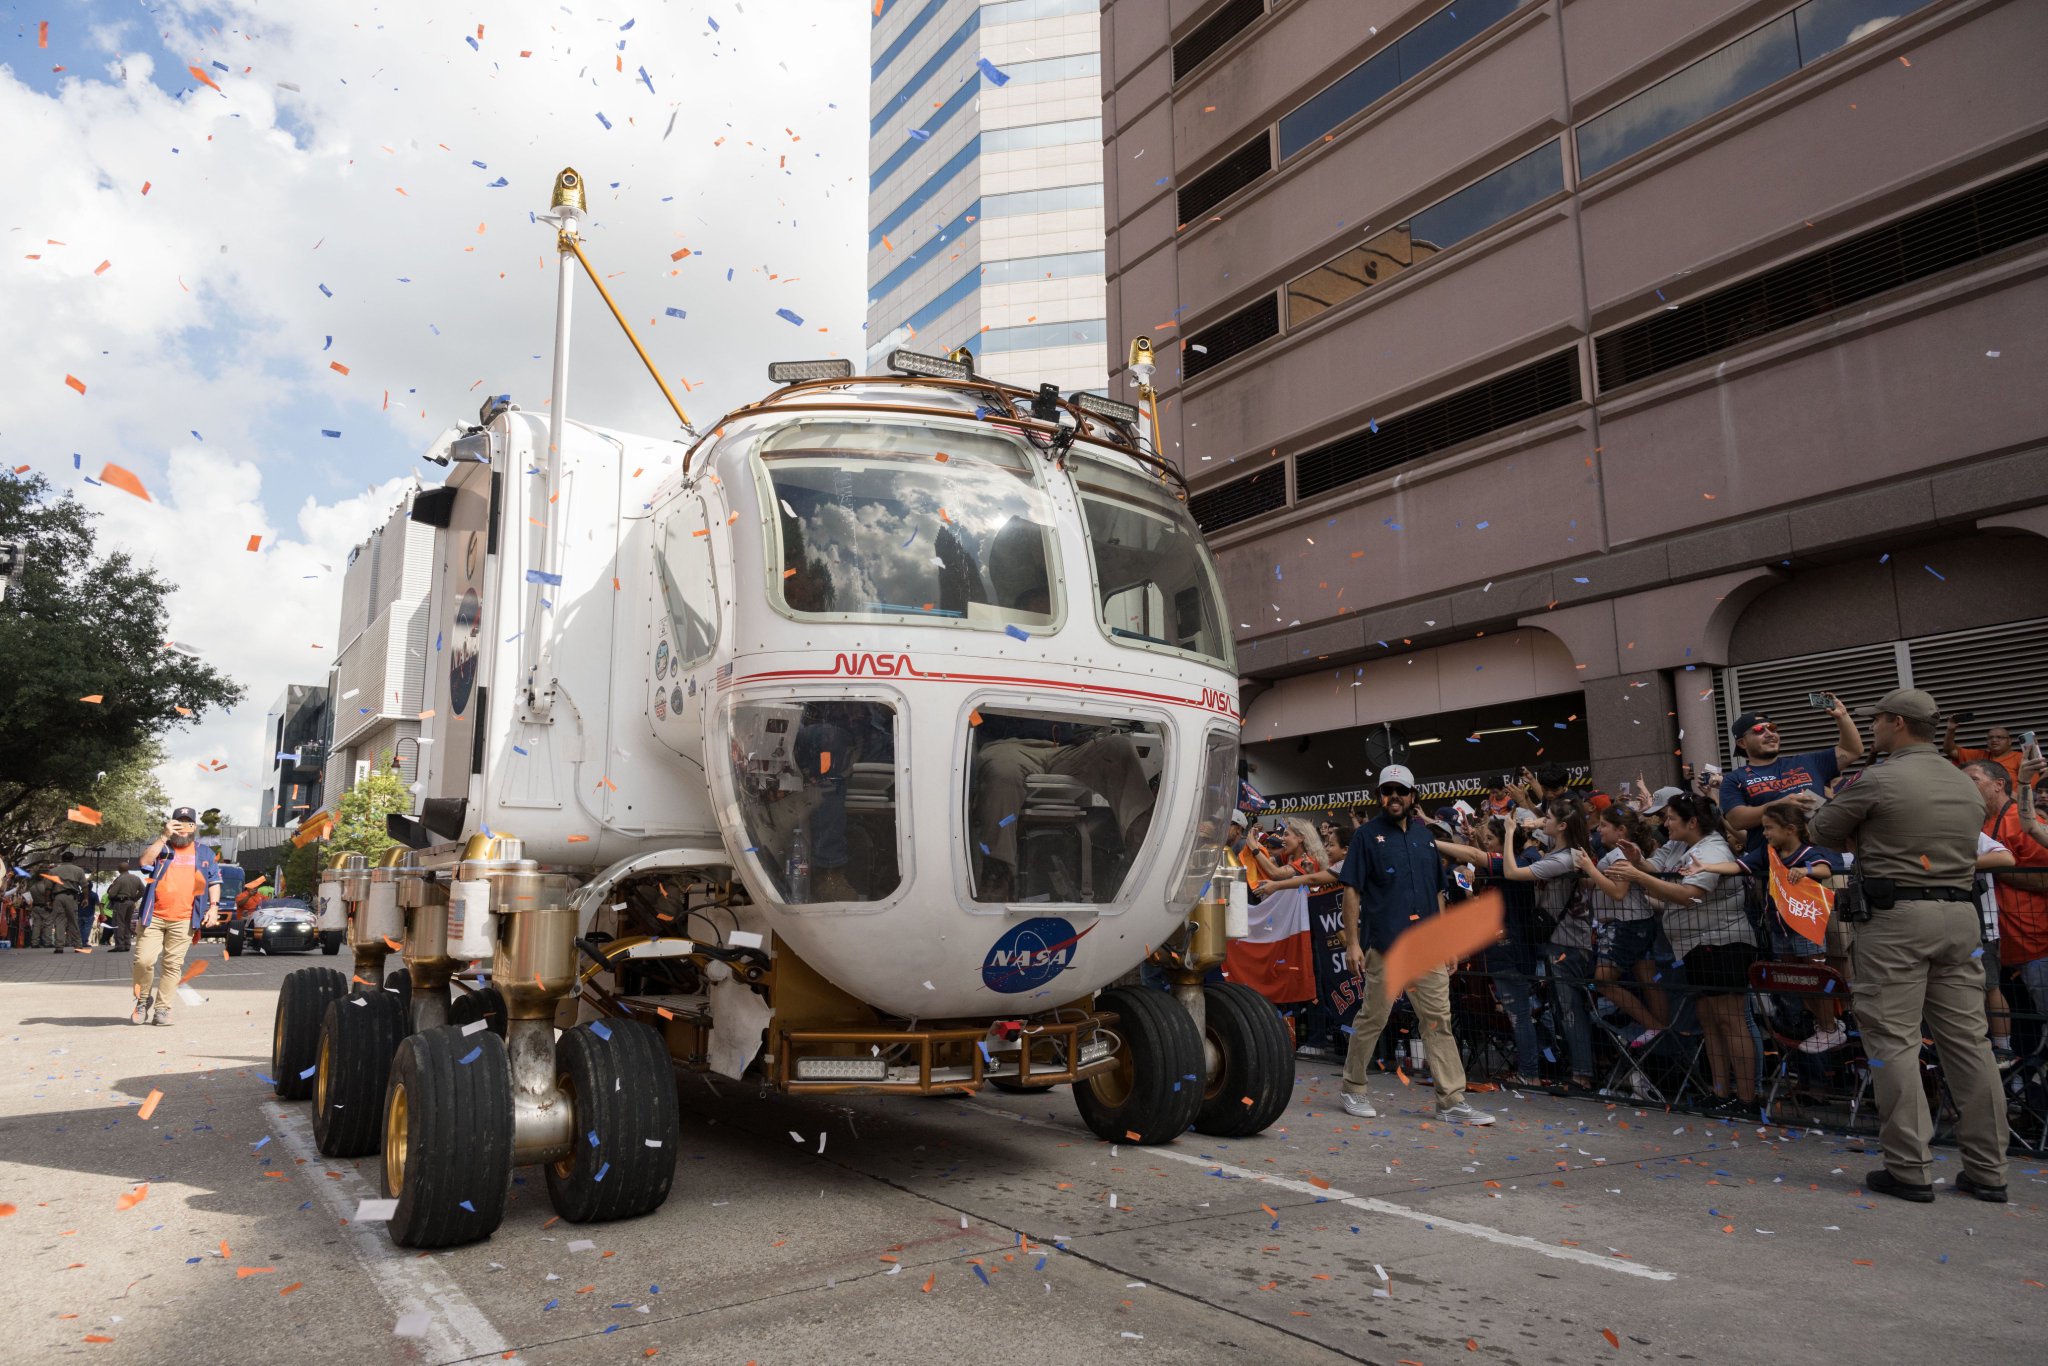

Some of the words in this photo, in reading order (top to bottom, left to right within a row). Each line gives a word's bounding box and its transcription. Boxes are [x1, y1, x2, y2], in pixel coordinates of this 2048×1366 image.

[833, 653, 915, 676] NASA
[1201, 687, 1233, 713] NASA
[1746, 775, 1777, 786] 2022
[1748, 773, 1811, 795] CHAMPS
[1281, 797, 1298, 809] DO
[1300, 794, 1326, 806] NOT
[1328, 789, 1371, 804] ENTER
[1414, 777, 1482, 795] ENTRANCE
[990, 948, 1067, 967] NASA
[1331, 975, 1364, 1015] AST
